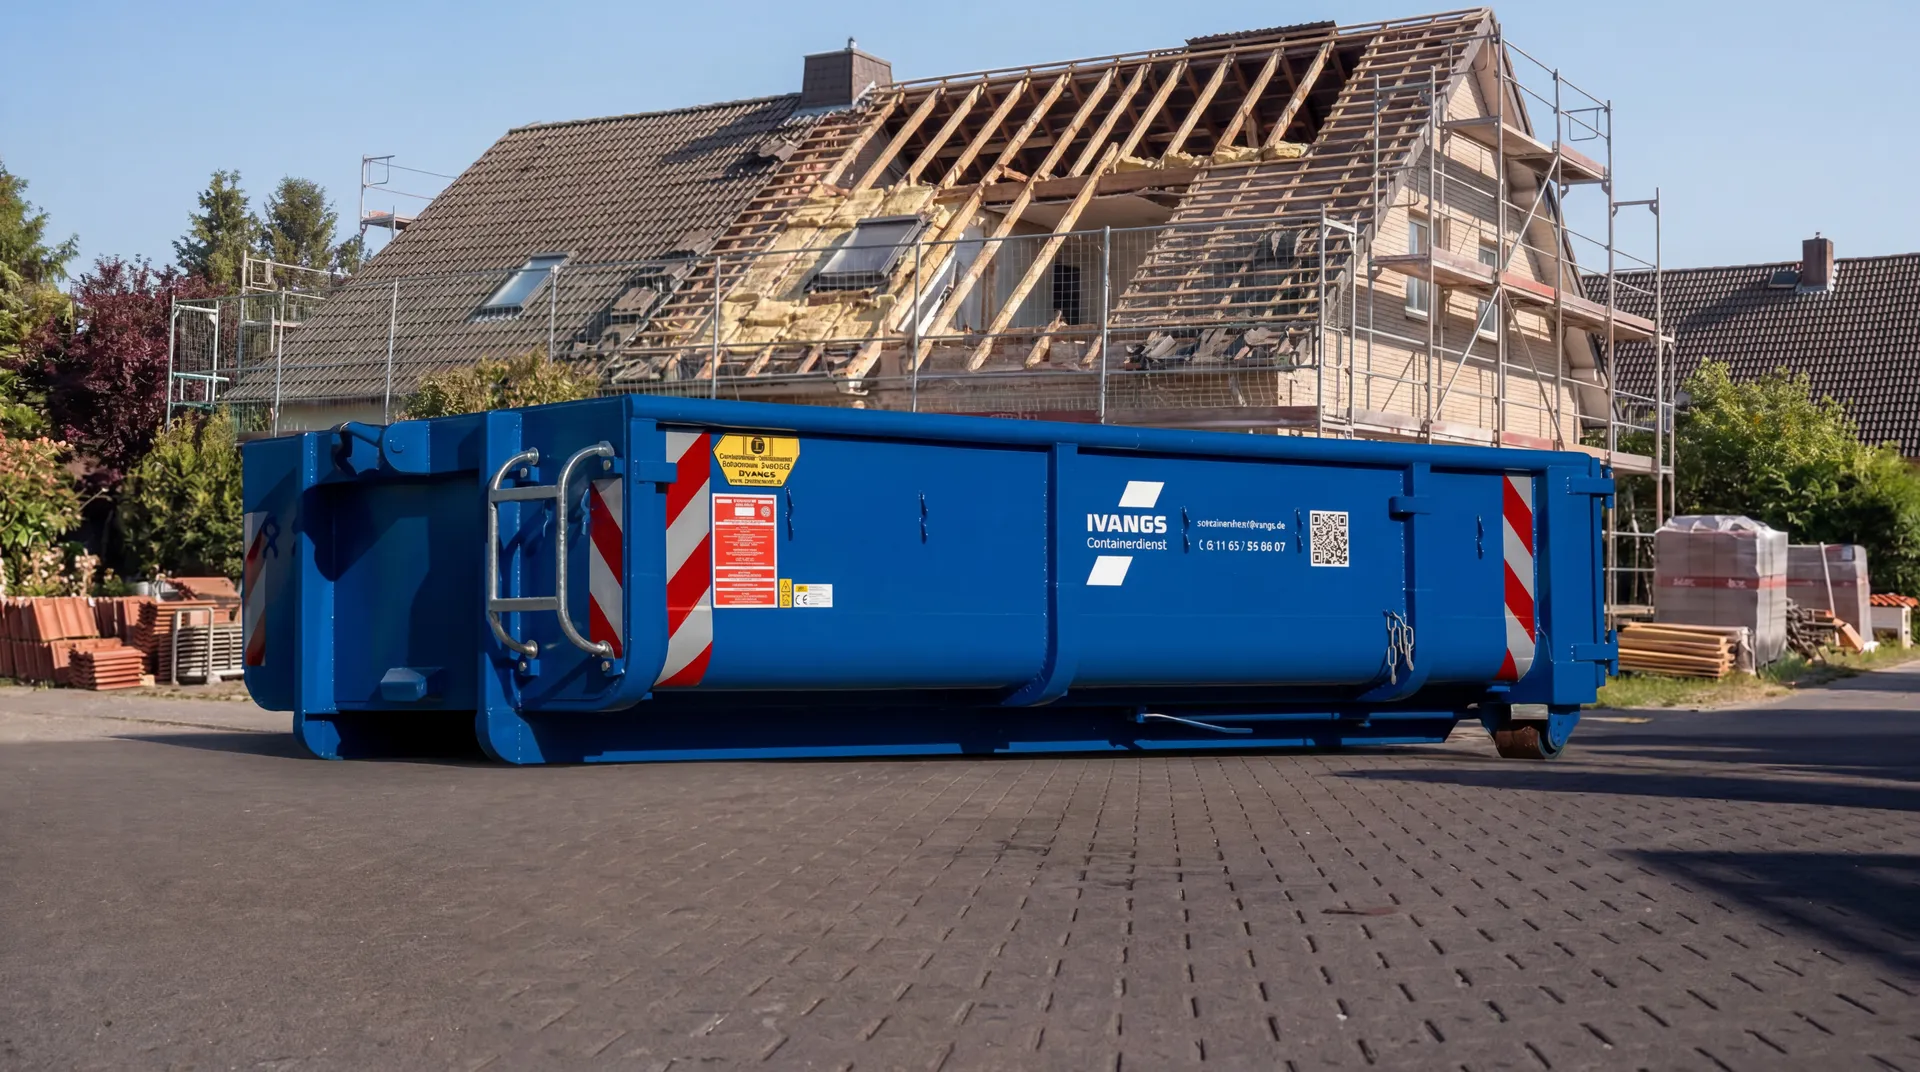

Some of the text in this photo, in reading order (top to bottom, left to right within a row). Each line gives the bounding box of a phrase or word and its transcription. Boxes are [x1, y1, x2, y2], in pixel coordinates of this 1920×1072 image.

[1087, 513, 1168, 534] IVANGS
[1086, 537, 1168, 551] Containerdienst
[1228, 540, 1240, 551] 65
[1247, 540, 1259, 552] 55
[1260, 541, 1273, 552] 86
[1274, 541, 1286, 552] 07
